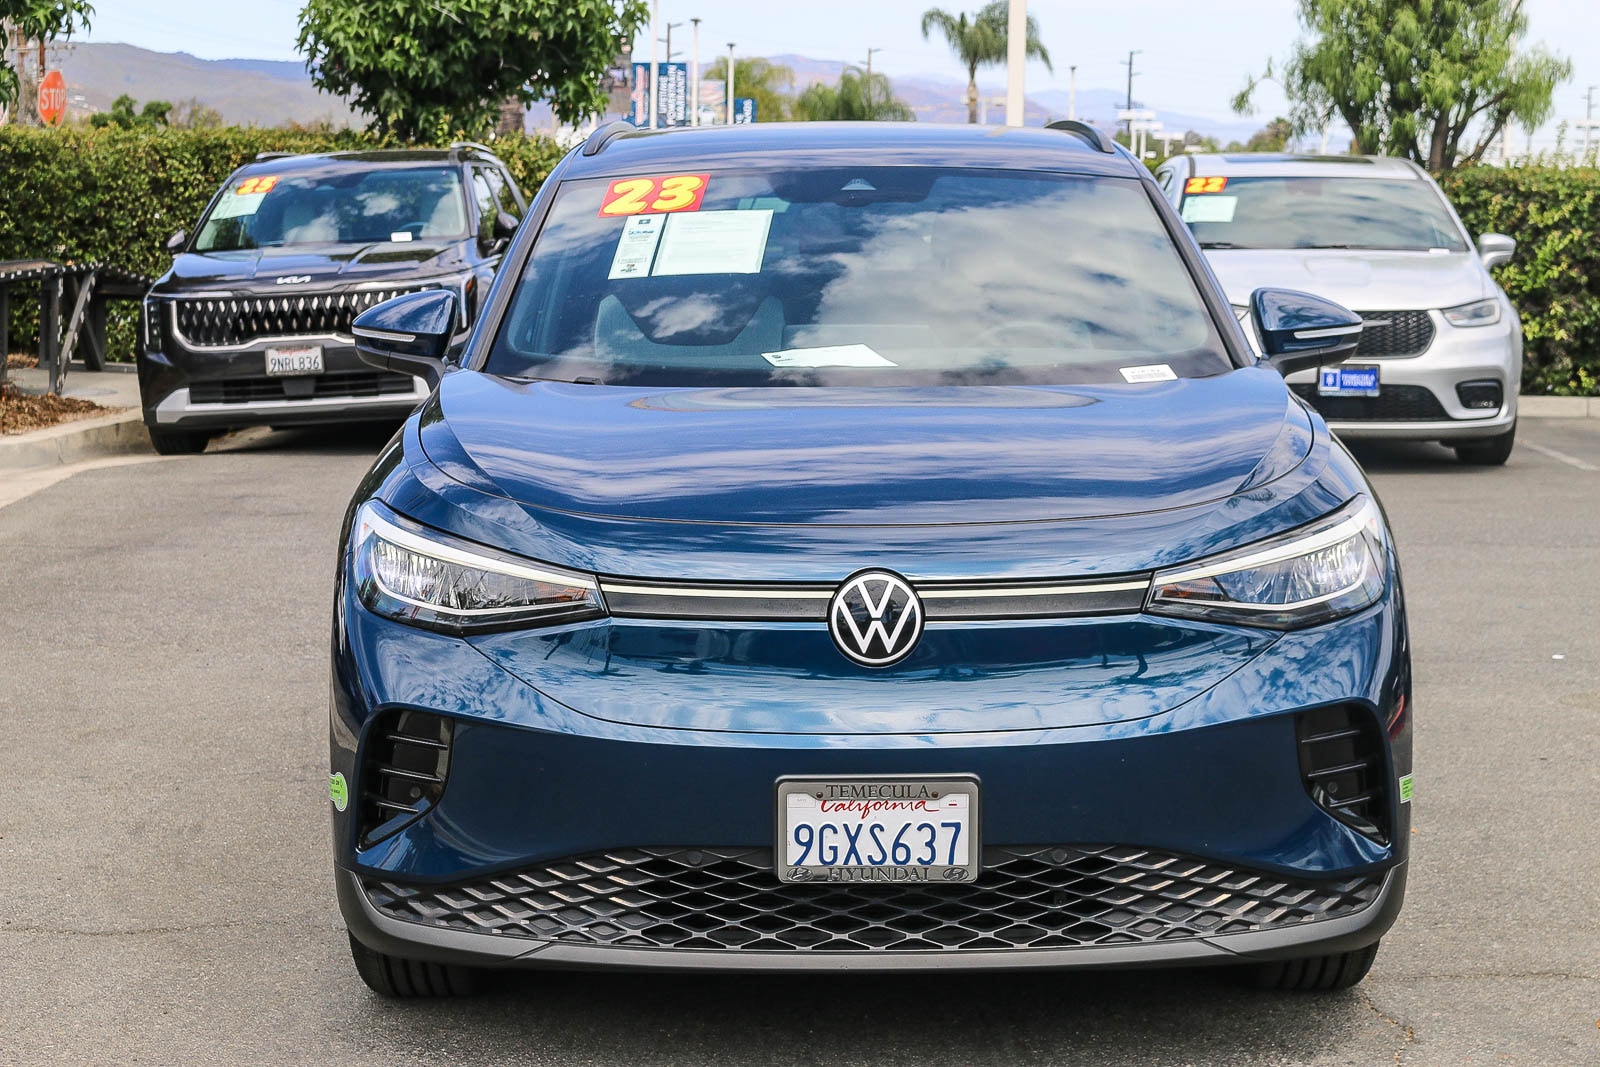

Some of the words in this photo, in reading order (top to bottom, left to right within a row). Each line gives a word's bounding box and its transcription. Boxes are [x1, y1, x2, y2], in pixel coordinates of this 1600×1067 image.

[41, 88, 66, 110] STOP
[1186, 176, 1225, 193] 22
[602, 175, 704, 215] 23
[270, 355, 320, 373] 9NRL836
[825, 784, 931, 799] TEMECULA
[820, 799, 940, 820] California
[793, 821, 962, 866] 9GXS637
[827, 867, 931, 882] HYUNDAI
